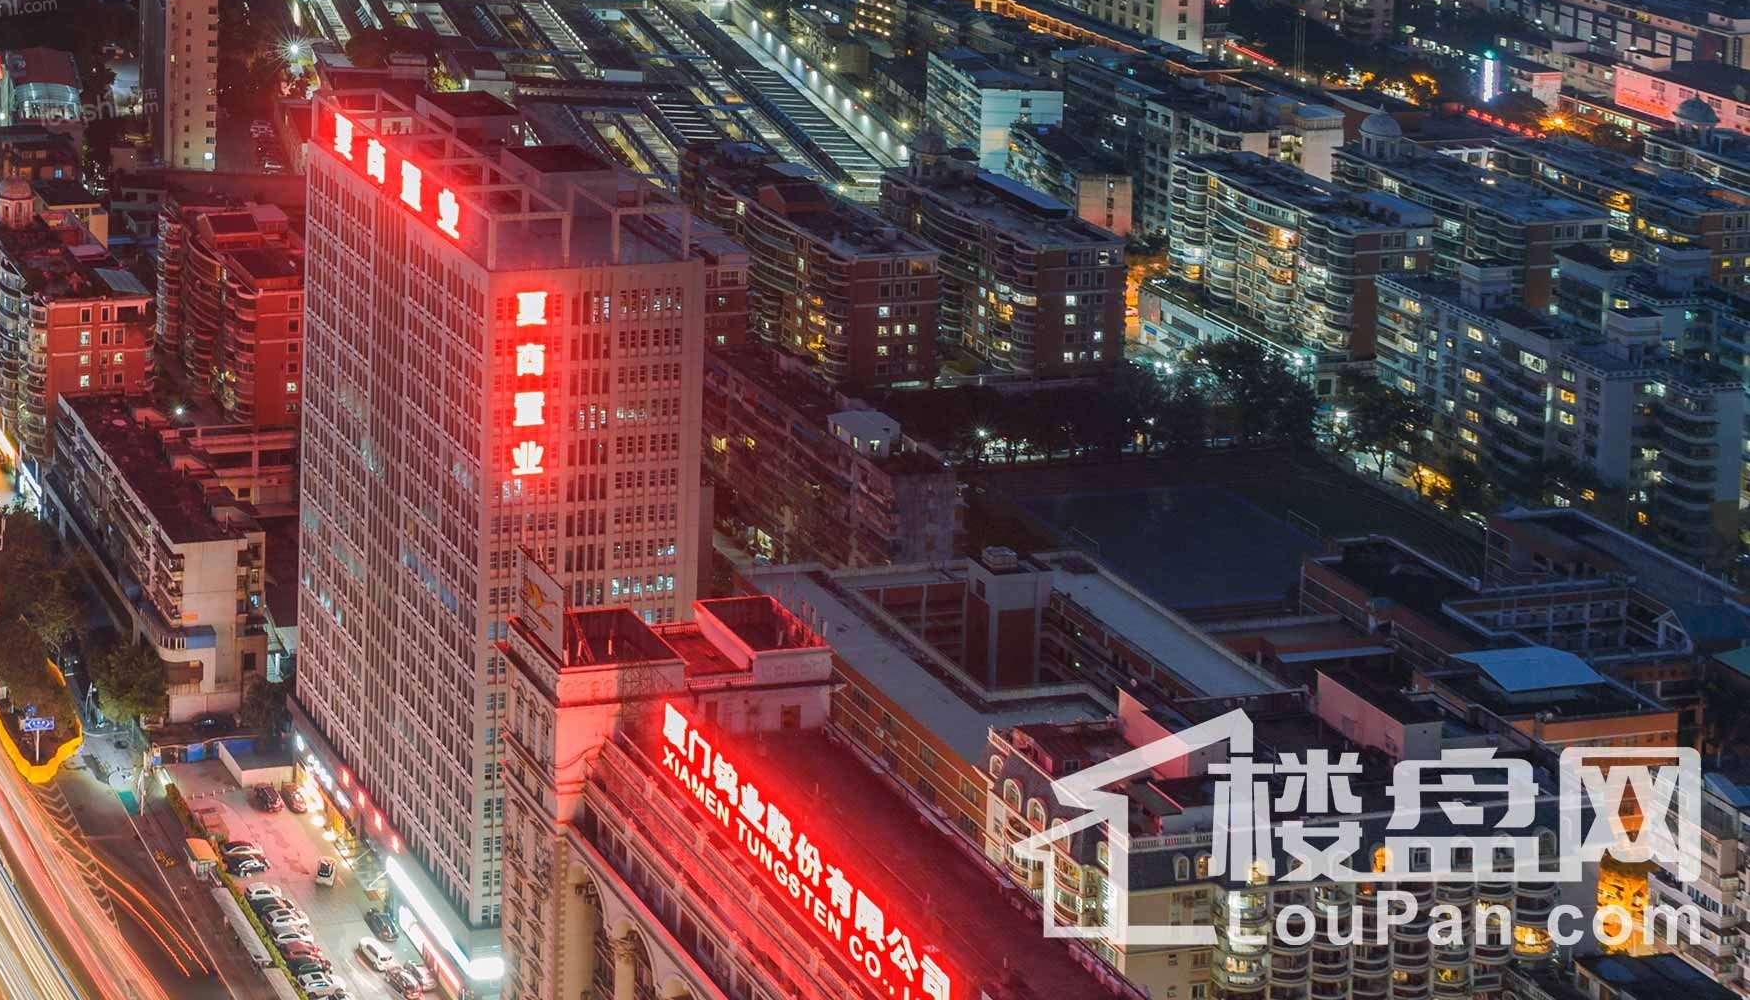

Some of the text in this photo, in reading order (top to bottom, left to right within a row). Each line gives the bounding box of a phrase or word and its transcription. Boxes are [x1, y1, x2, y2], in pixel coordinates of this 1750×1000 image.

[663, 746, 730, 827] XIAMEN
[736, 817, 842, 940] TUNGSTEN
[663, 702, 950, 1000] 厦门钨业股份有限公司
